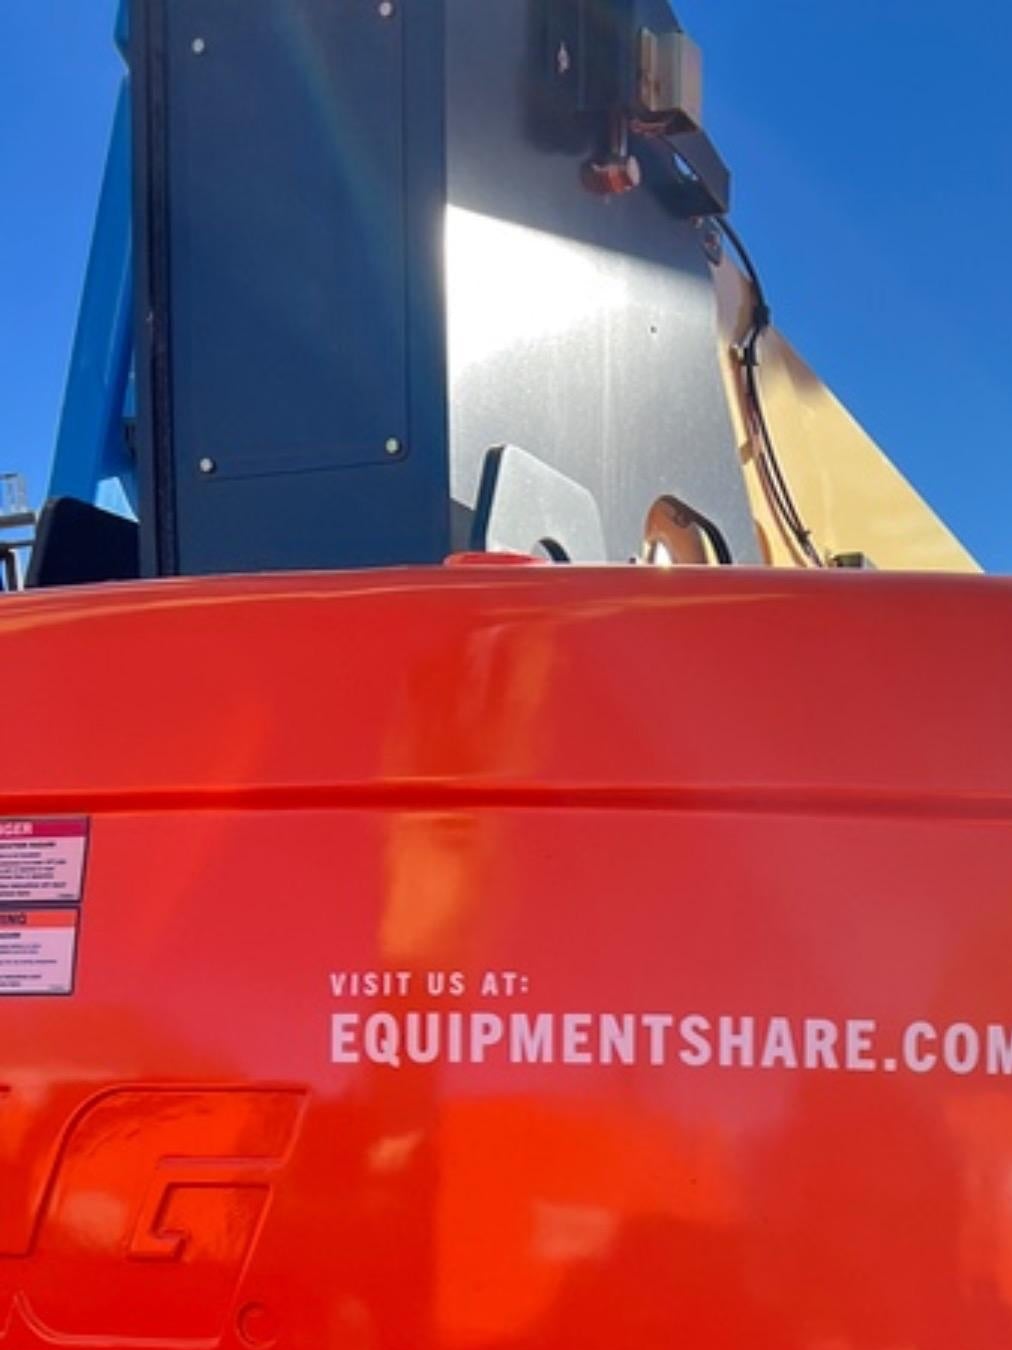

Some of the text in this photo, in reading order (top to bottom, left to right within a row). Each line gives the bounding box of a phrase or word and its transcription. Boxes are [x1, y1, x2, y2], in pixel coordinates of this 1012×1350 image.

[329, 972, 530, 997] VISIT US AT:
